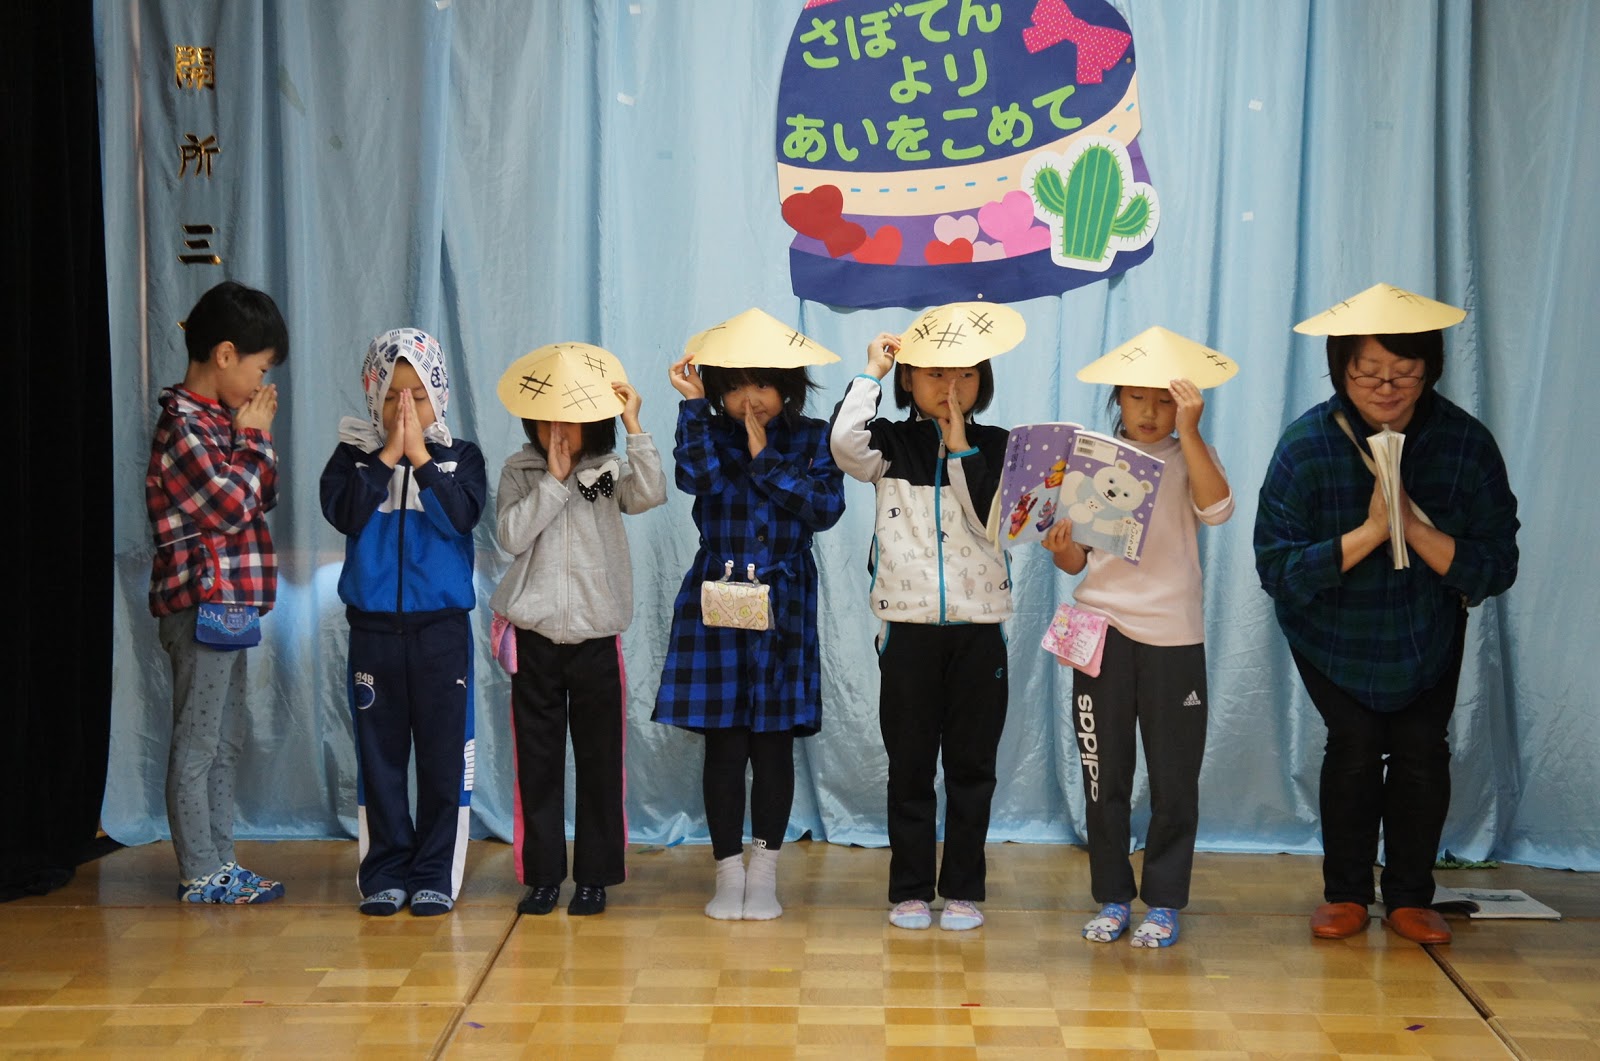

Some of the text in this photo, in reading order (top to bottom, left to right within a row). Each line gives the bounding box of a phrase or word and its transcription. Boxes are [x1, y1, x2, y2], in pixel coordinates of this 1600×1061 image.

[800, 0, 1001, 68] さぼてん
[890, 49, 988, 103] より
[783, 85, 1082, 162] あいをこめて
[1078, 695, 1098, 802] adidas
